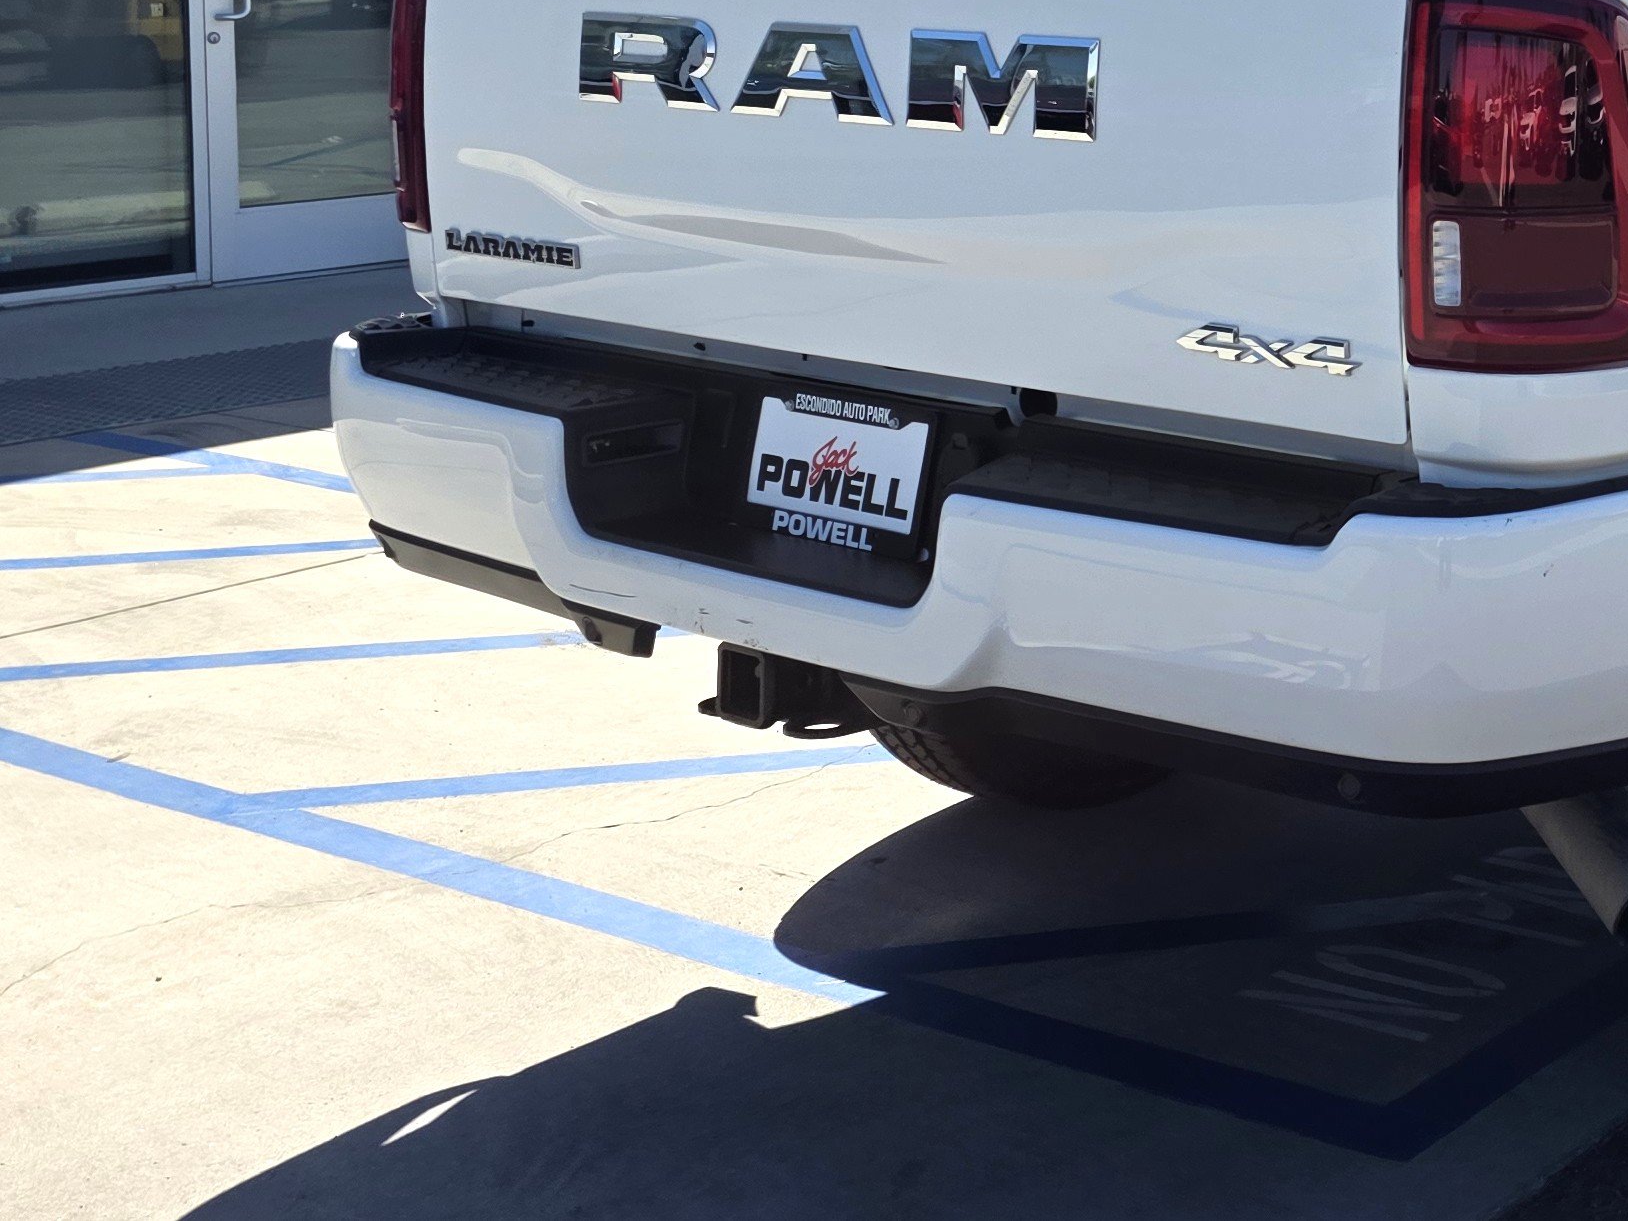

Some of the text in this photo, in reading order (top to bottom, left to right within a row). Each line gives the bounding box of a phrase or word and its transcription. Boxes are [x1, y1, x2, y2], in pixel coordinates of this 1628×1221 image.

[579, 11, 1101, 143] RAM
[445, 227, 581, 269] LARAMIE
[795, 393, 892, 425] ESCONDIDO AUTO PARK
[808, 436, 859, 486] Jack
[756, 453, 909, 521] POWELL
[772, 510, 873, 552] POWELL
